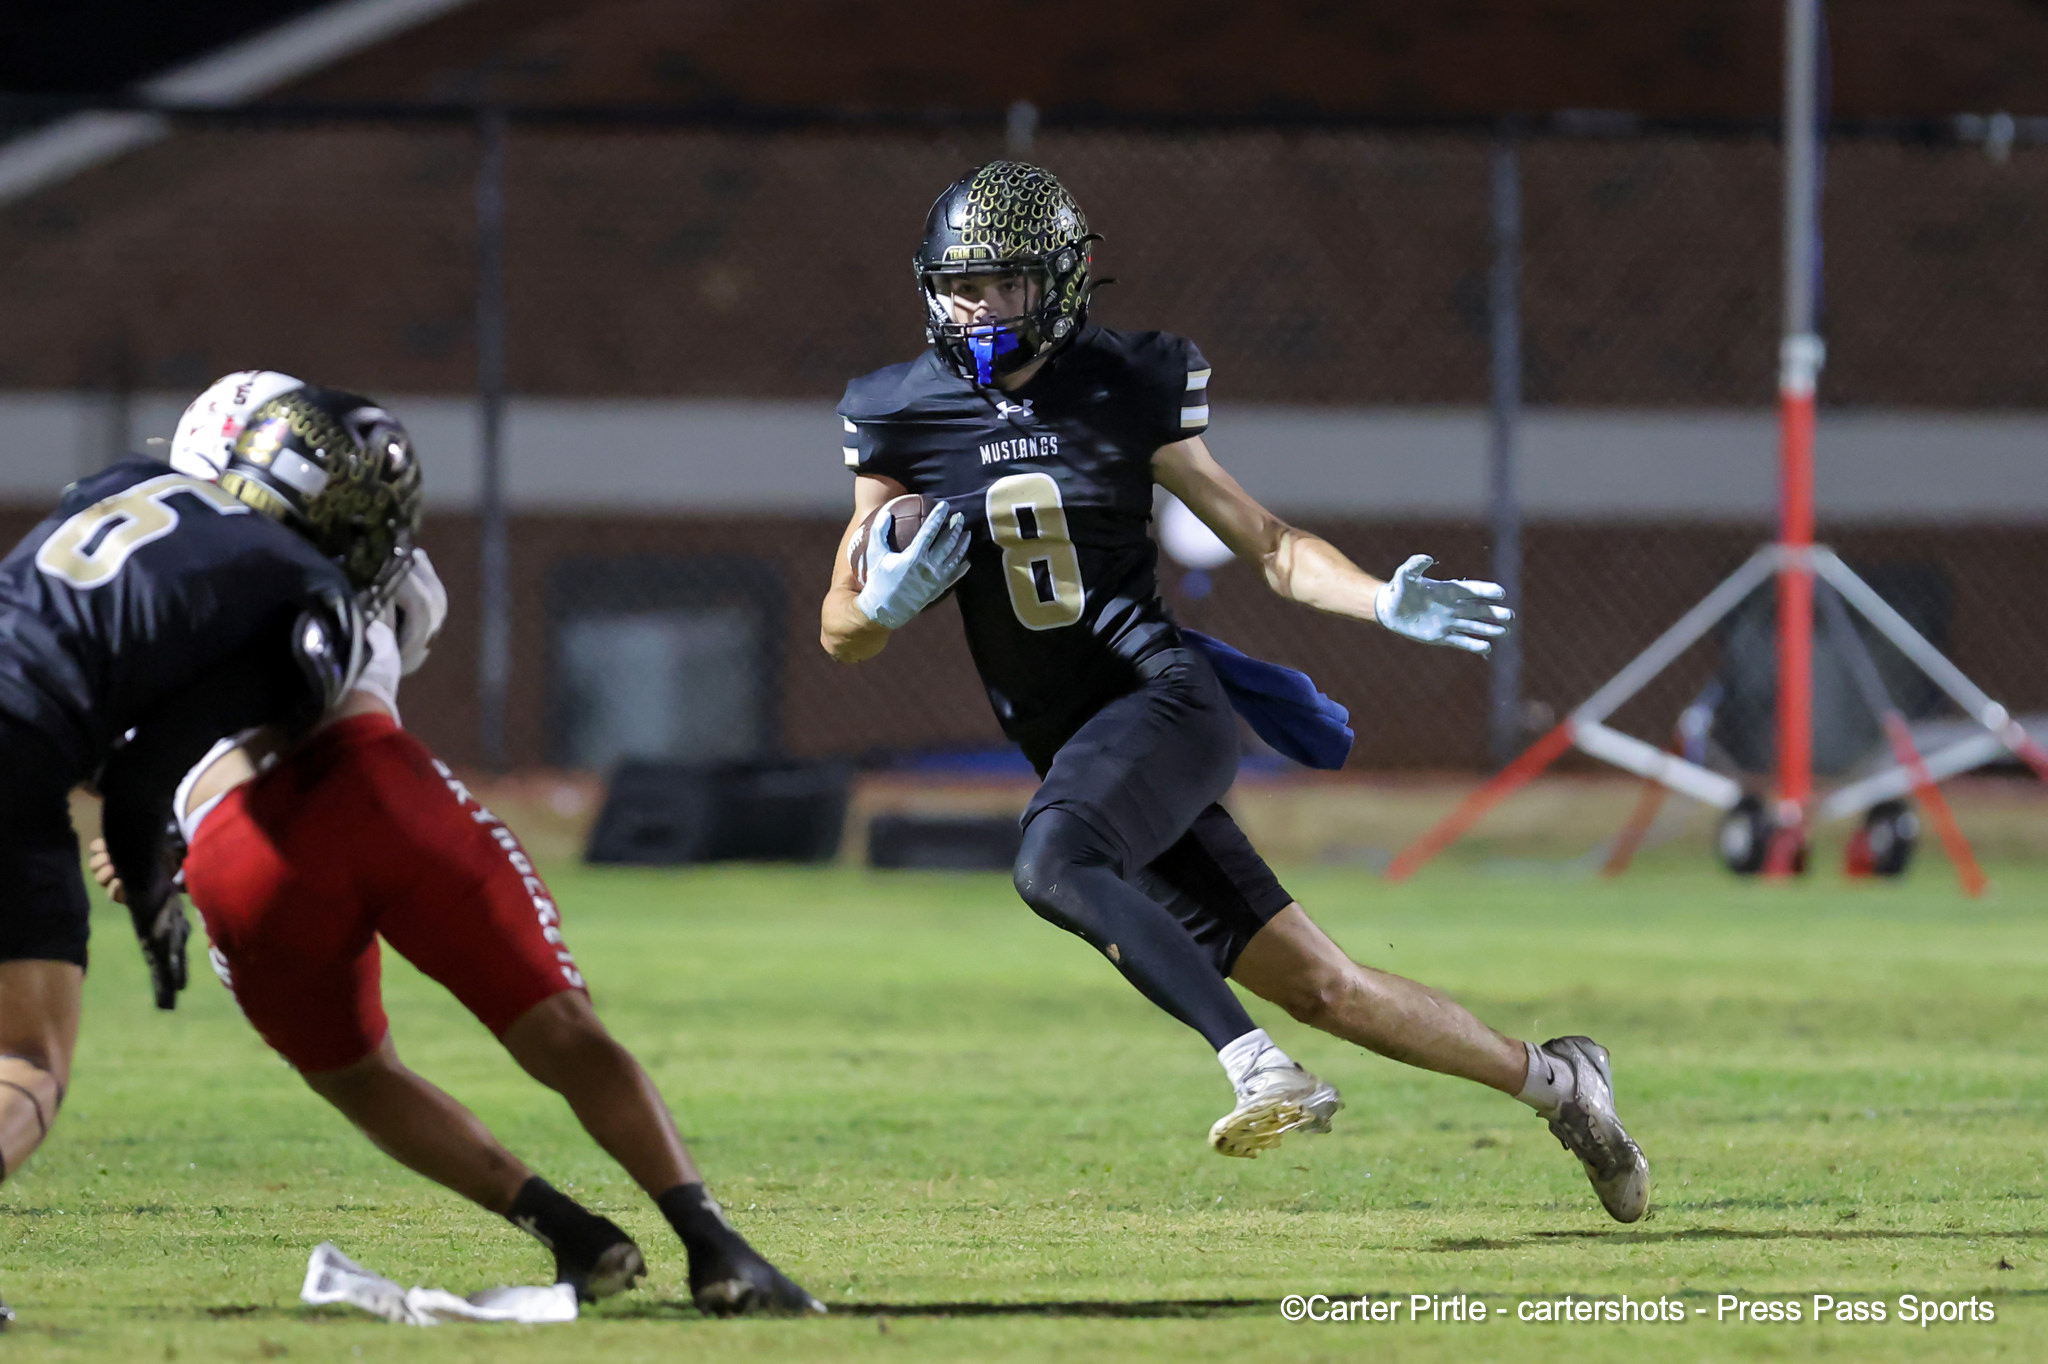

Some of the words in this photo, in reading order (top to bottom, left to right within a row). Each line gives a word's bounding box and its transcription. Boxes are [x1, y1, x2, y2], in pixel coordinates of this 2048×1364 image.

[979, 435, 1060, 466] MUSTANGS
[35, 472, 249, 591] 6
[985, 471, 1087, 632] 8
